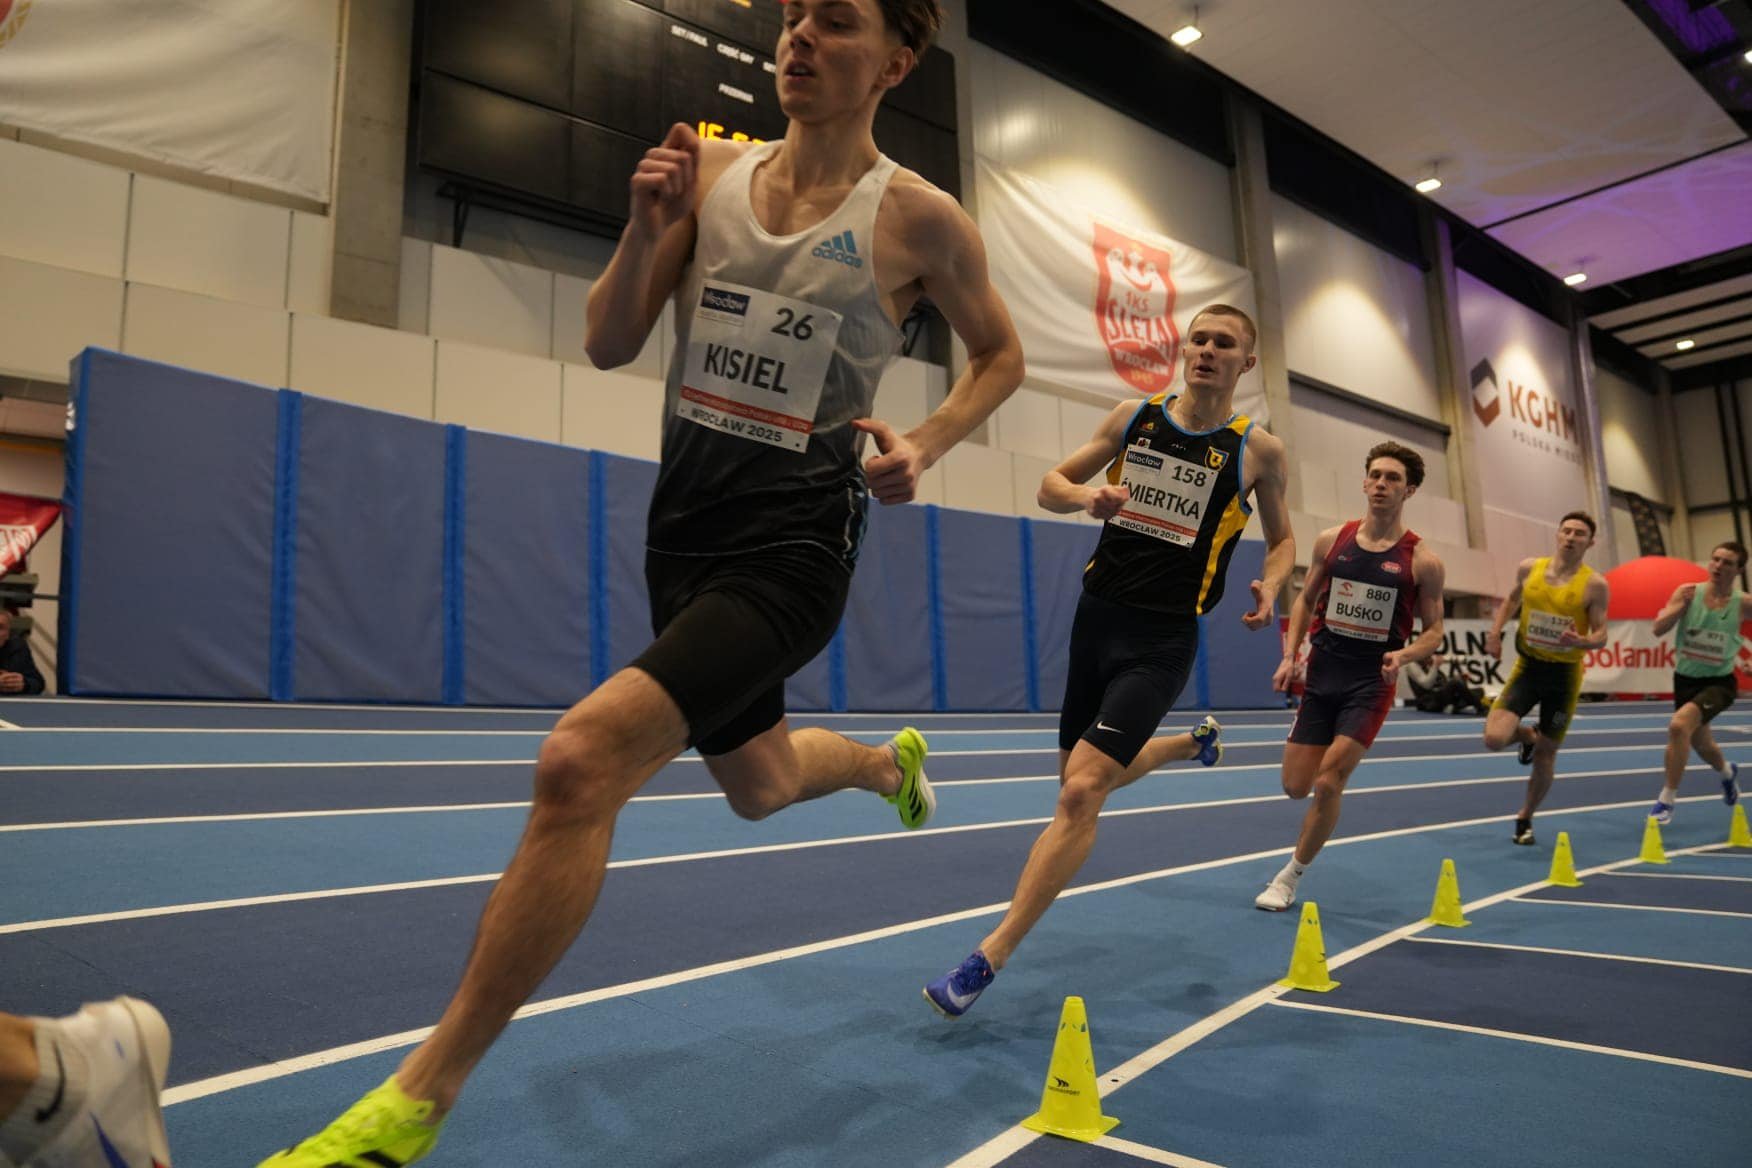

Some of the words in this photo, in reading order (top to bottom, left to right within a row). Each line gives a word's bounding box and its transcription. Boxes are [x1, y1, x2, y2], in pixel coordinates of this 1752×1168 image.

[812, 246, 863, 269] adidas
[771, 307, 814, 341] 26
[703, 342, 788, 395] KISIEL
[747, 424, 784, 442] 2025
[1128, 451, 1161, 467] Wrocław
[1171, 465, 1207, 487] 158
[1160, 529, 1182, 542] 2025
[1366, 588, 1391, 602] 880
